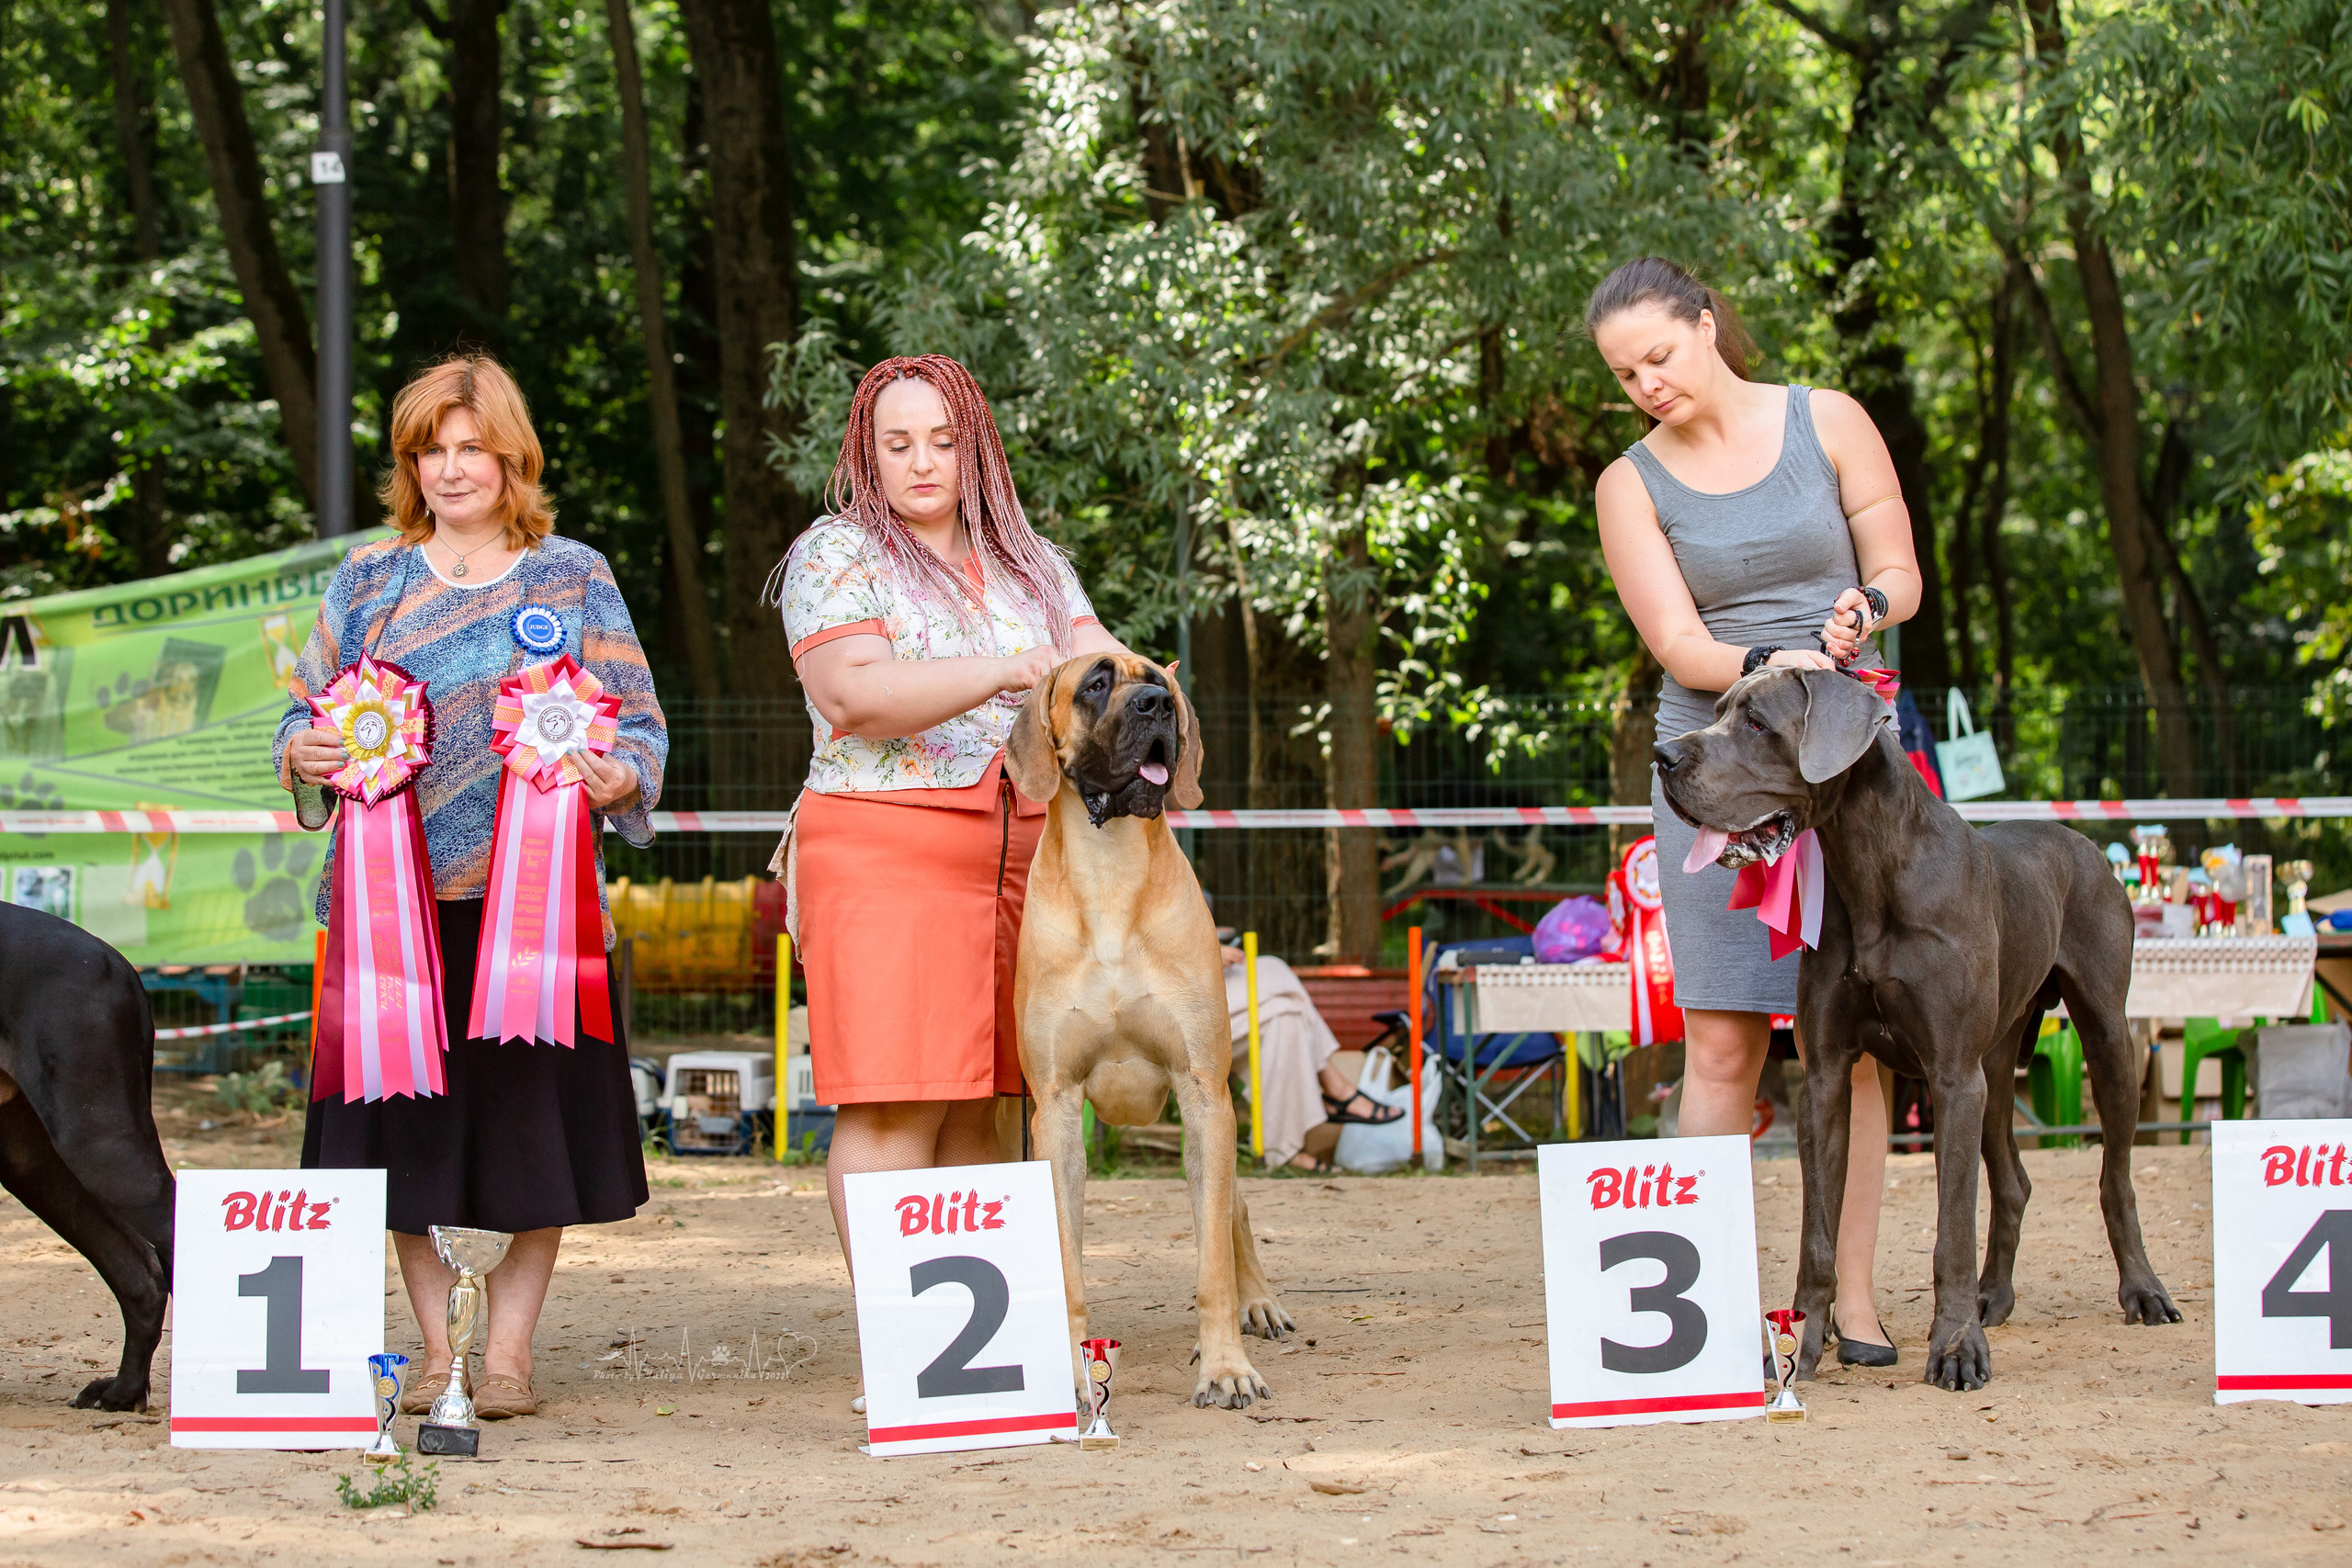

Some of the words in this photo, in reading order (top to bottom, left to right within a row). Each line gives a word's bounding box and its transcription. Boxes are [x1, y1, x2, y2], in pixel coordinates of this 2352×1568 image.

[236, 1256, 330, 1394] 1
[910, 1256, 1025, 1399] 2
[1599, 1231, 1708, 1374] 3
[2262, 1209, 2352, 1349] 4
